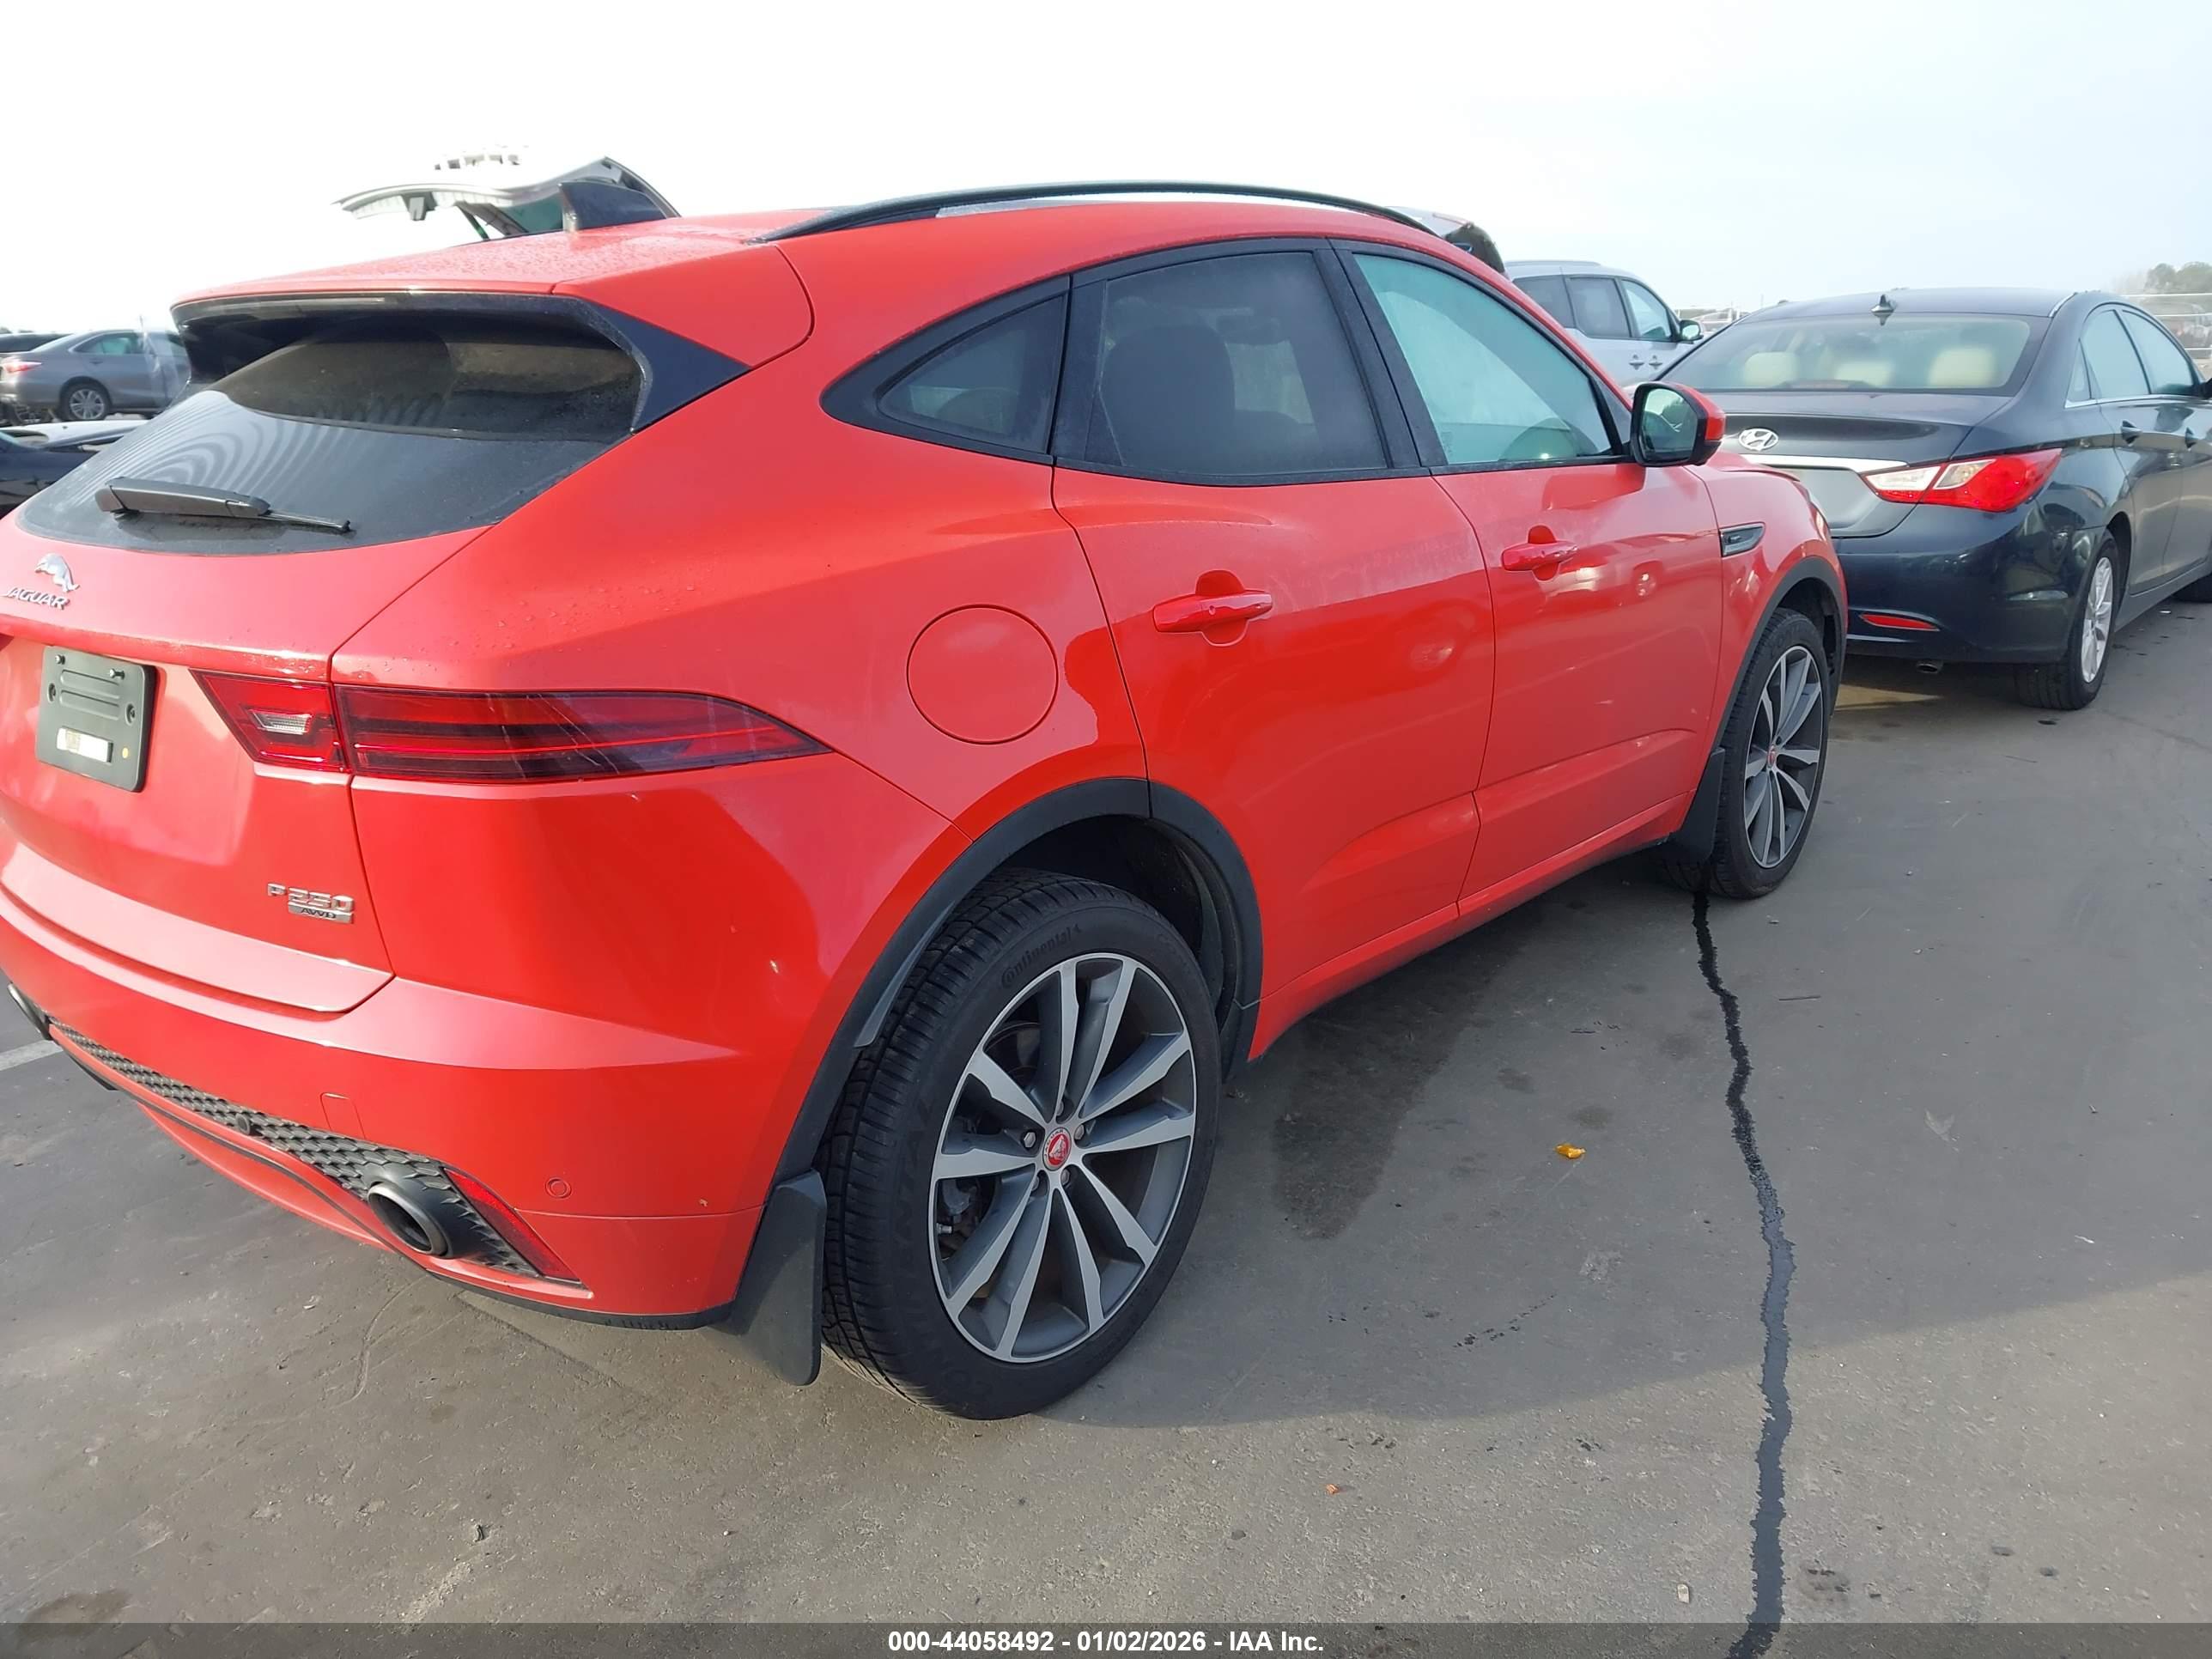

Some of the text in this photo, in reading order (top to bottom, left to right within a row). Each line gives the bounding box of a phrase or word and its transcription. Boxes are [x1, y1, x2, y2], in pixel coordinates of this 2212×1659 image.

[2, 587, 70, 610] JAGUAR
[267, 883, 354, 913] P250
[301, 908, 337, 920] AWD
[1001, 926, 1073, 988] Continental
